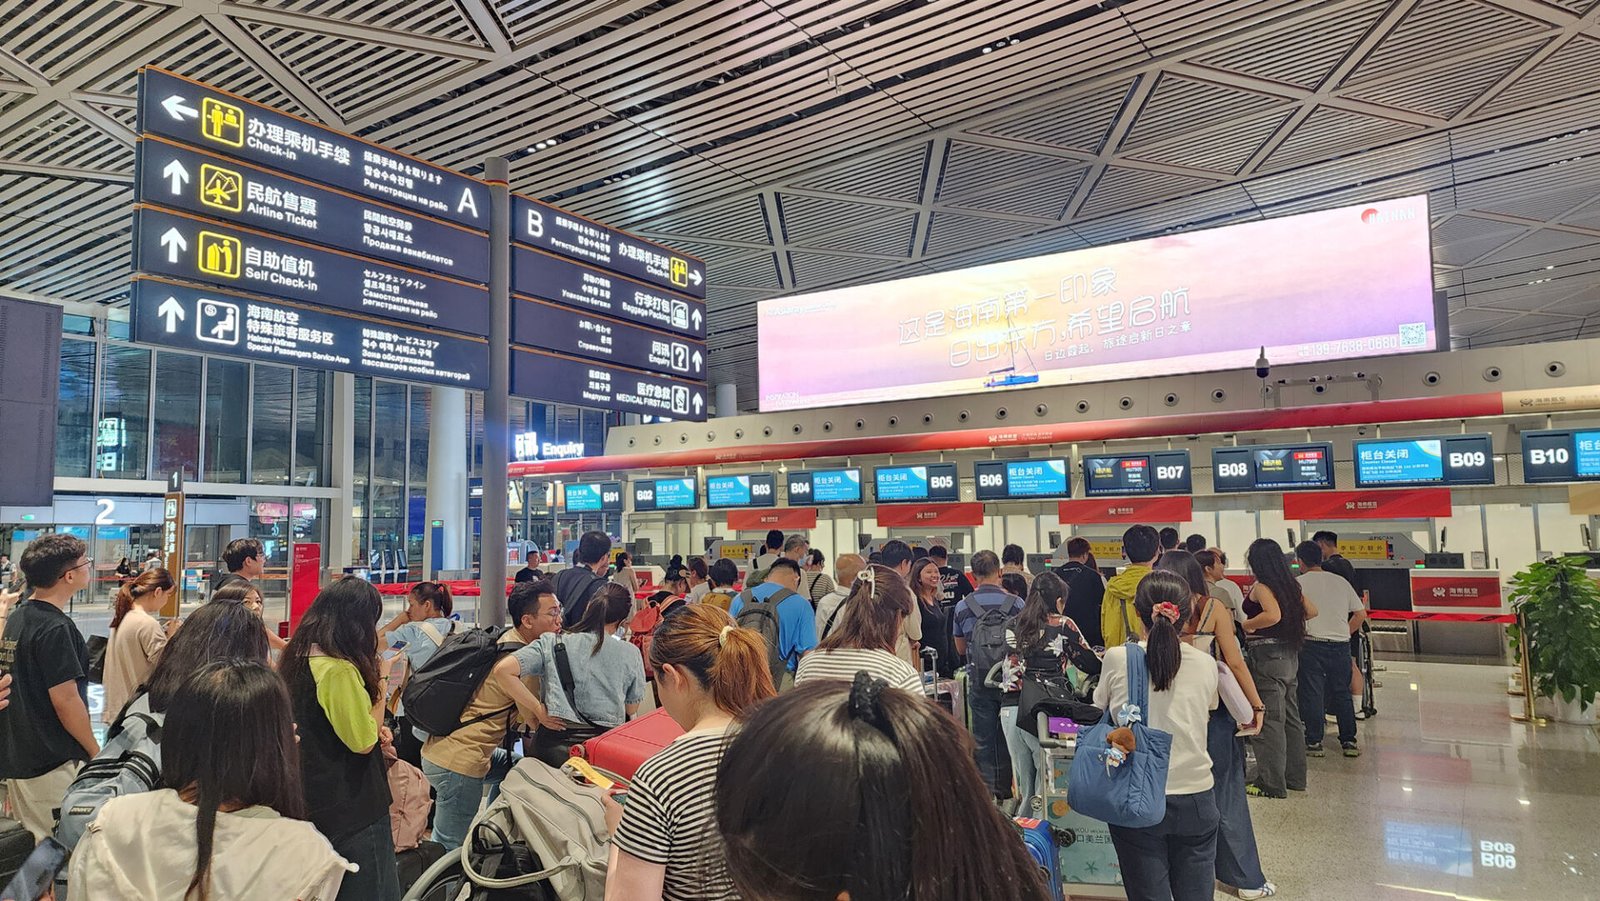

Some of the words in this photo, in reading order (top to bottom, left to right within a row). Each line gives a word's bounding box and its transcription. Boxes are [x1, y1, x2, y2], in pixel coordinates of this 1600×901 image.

[247, 137, 297, 160] Check-in
[248, 117, 350, 166] 办理乘机手续
[247, 181, 317, 216] 民航售票
[364, 178, 417, 202] Регистрация
[457, 187, 478, 218] A
[247, 203, 284, 220] Airline
[286, 212, 318, 230] Ticket
[527, 208, 544, 237] B
[362, 235, 402, 253] Продажа
[245, 246, 315, 278] 自助值机
[619, 242, 669, 270] 办理乘机手续
[245, 268, 269, 282] Self
[270, 272, 318, 292] Check-in
[363, 269, 427, 290] セルフチェックイン
[647, 265, 670, 278] Check-in
[363, 289, 429, 309] Самостоятельная
[634, 291, 670, 312] 行李打包
[898, 266, 1118, 345] 这是海南第一印象
[247, 304, 299, 325] 海南航空
[622, 302, 649, 317] Baggage
[649, 308, 671, 323] Packing
[246, 319, 335, 346] 特殊旅客服务区
[247, 334, 271, 345] Hainan
[271, 337, 297, 348] Airlines
[247, 342, 272, 353] Special
[274, 345, 311, 359] Passengers
[312, 352, 335, 362] Service
[335, 354, 350, 364] Area
[652, 341, 670, 357] 问讯
[649, 354, 670, 367] Enquiry
[637, 382, 670, 400] 医疗急救
[616, 393, 643, 405] MEDICAL
[643, 397, 661, 408] FIRST
[661, 400, 671, 409] AID
[542, 441, 585, 457] Enquiry
[1361, 449, 1409, 460] 柜台关闭
[1530, 448, 1569, 464] B10
[1449, 452, 1485, 467] B09
[878, 473, 907, 482] 柜台关闭
[1009, 466, 1043, 476] 柜台关闭
[1157, 466, 1184, 479] B07
[1218, 463, 1247, 477] B08
[172, 471, 178, 488] 1
[791, 482, 810, 494] B04
[814, 476, 842, 484] 柜台关闭
[931, 476, 953, 488] B05
[979, 474, 1003, 486] B06
[603, 491, 619, 502] B01
[637, 490, 653, 500] B02
[752, 484, 771, 495] B03
[95, 498, 116, 525] 2
